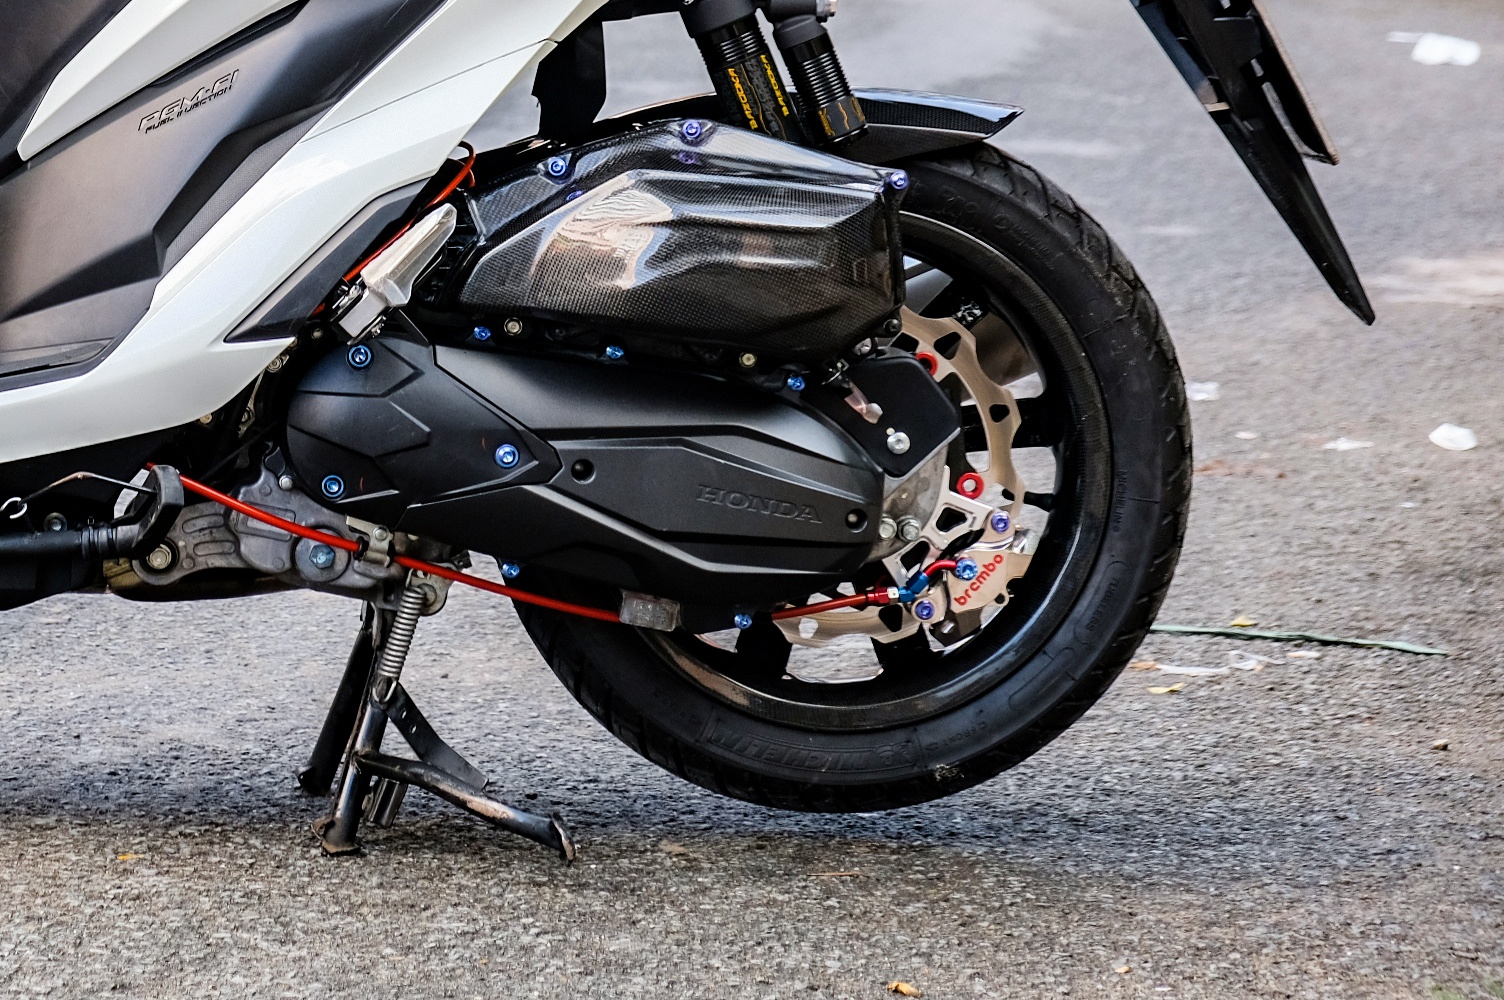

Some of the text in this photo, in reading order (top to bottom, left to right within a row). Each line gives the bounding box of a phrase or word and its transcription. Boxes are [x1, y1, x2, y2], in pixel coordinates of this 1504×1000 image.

[727, 68, 759, 131] BAZOOKA
[760, 54, 790, 117] BAZOOKA
[145, 116, 175, 134] FUEL
[695, 485, 824, 525] HONDA
[954, 553, 1005, 607] brembo
